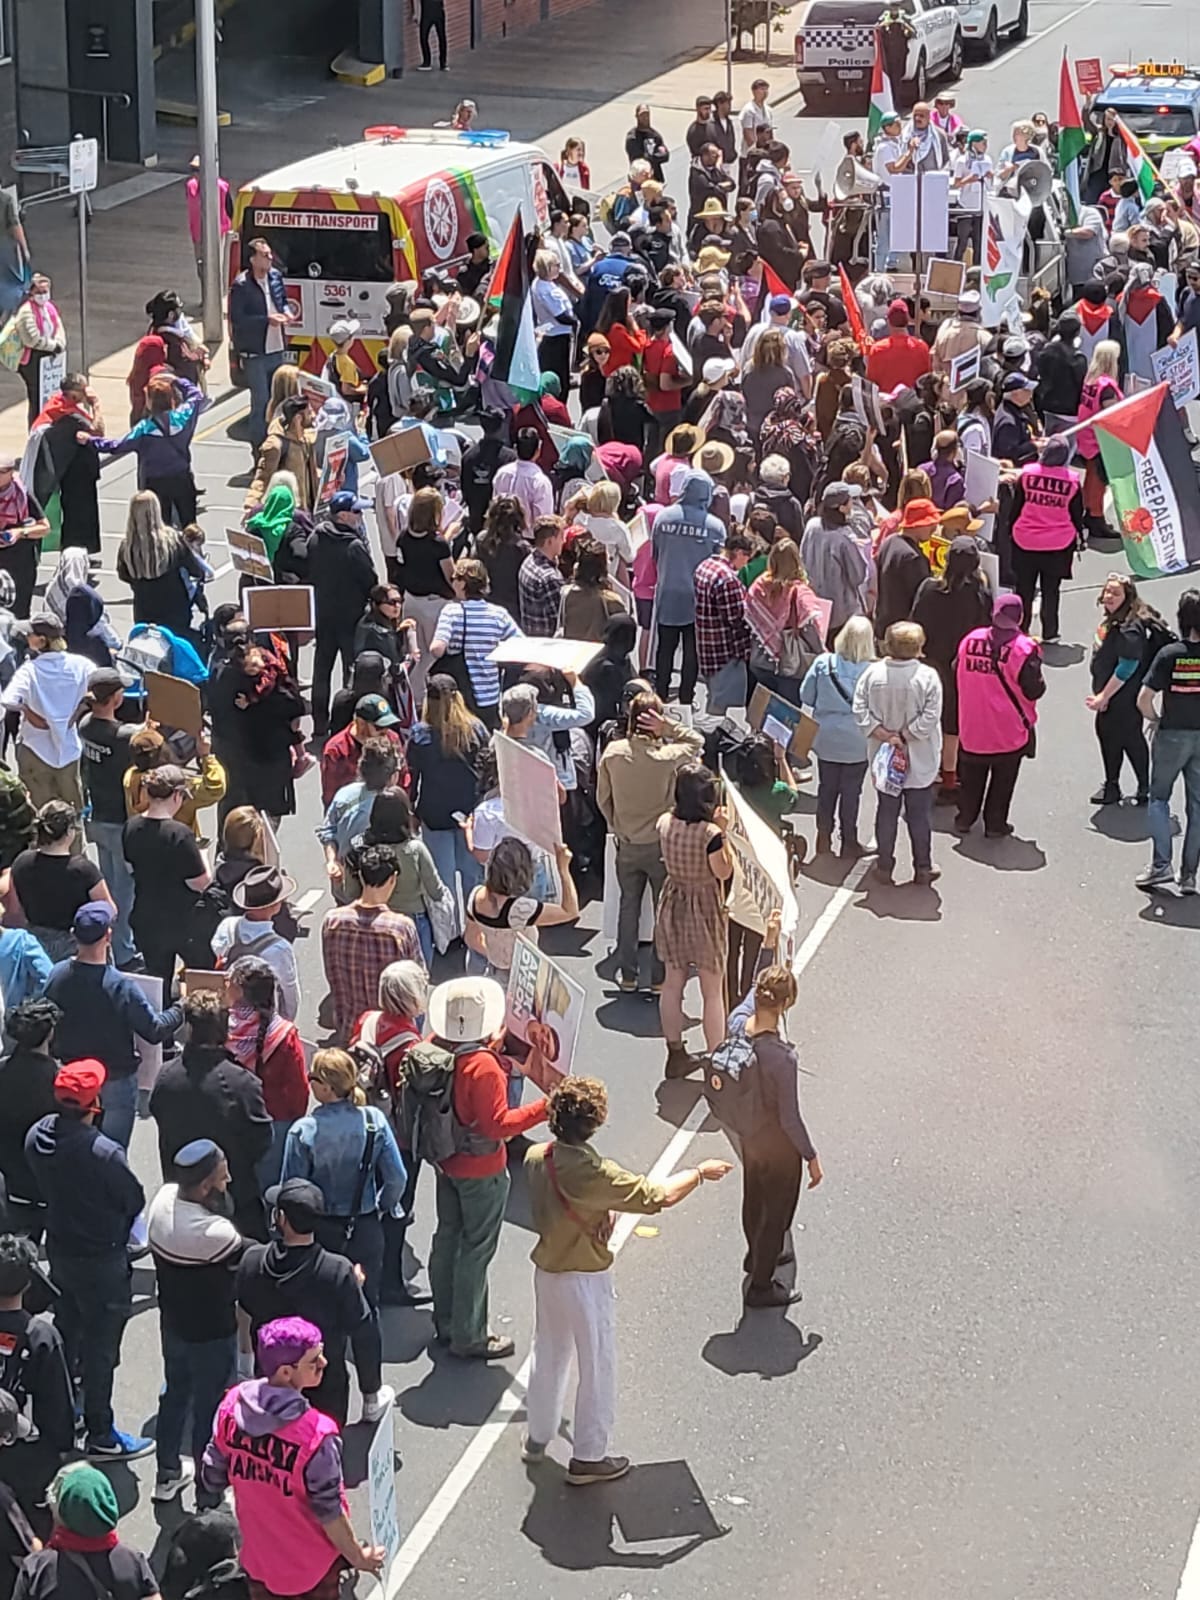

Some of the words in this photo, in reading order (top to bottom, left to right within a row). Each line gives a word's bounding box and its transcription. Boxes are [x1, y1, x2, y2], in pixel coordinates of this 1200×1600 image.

[828, 58, 870, 66] Police
[256, 212, 302, 226] PATIENT
[304, 214, 377, 229] TRANSPORT
[324, 285, 352, 297] 5361
[1141, 459, 1162, 497] FREE
[512, 948, 531, 1019] DYSON
